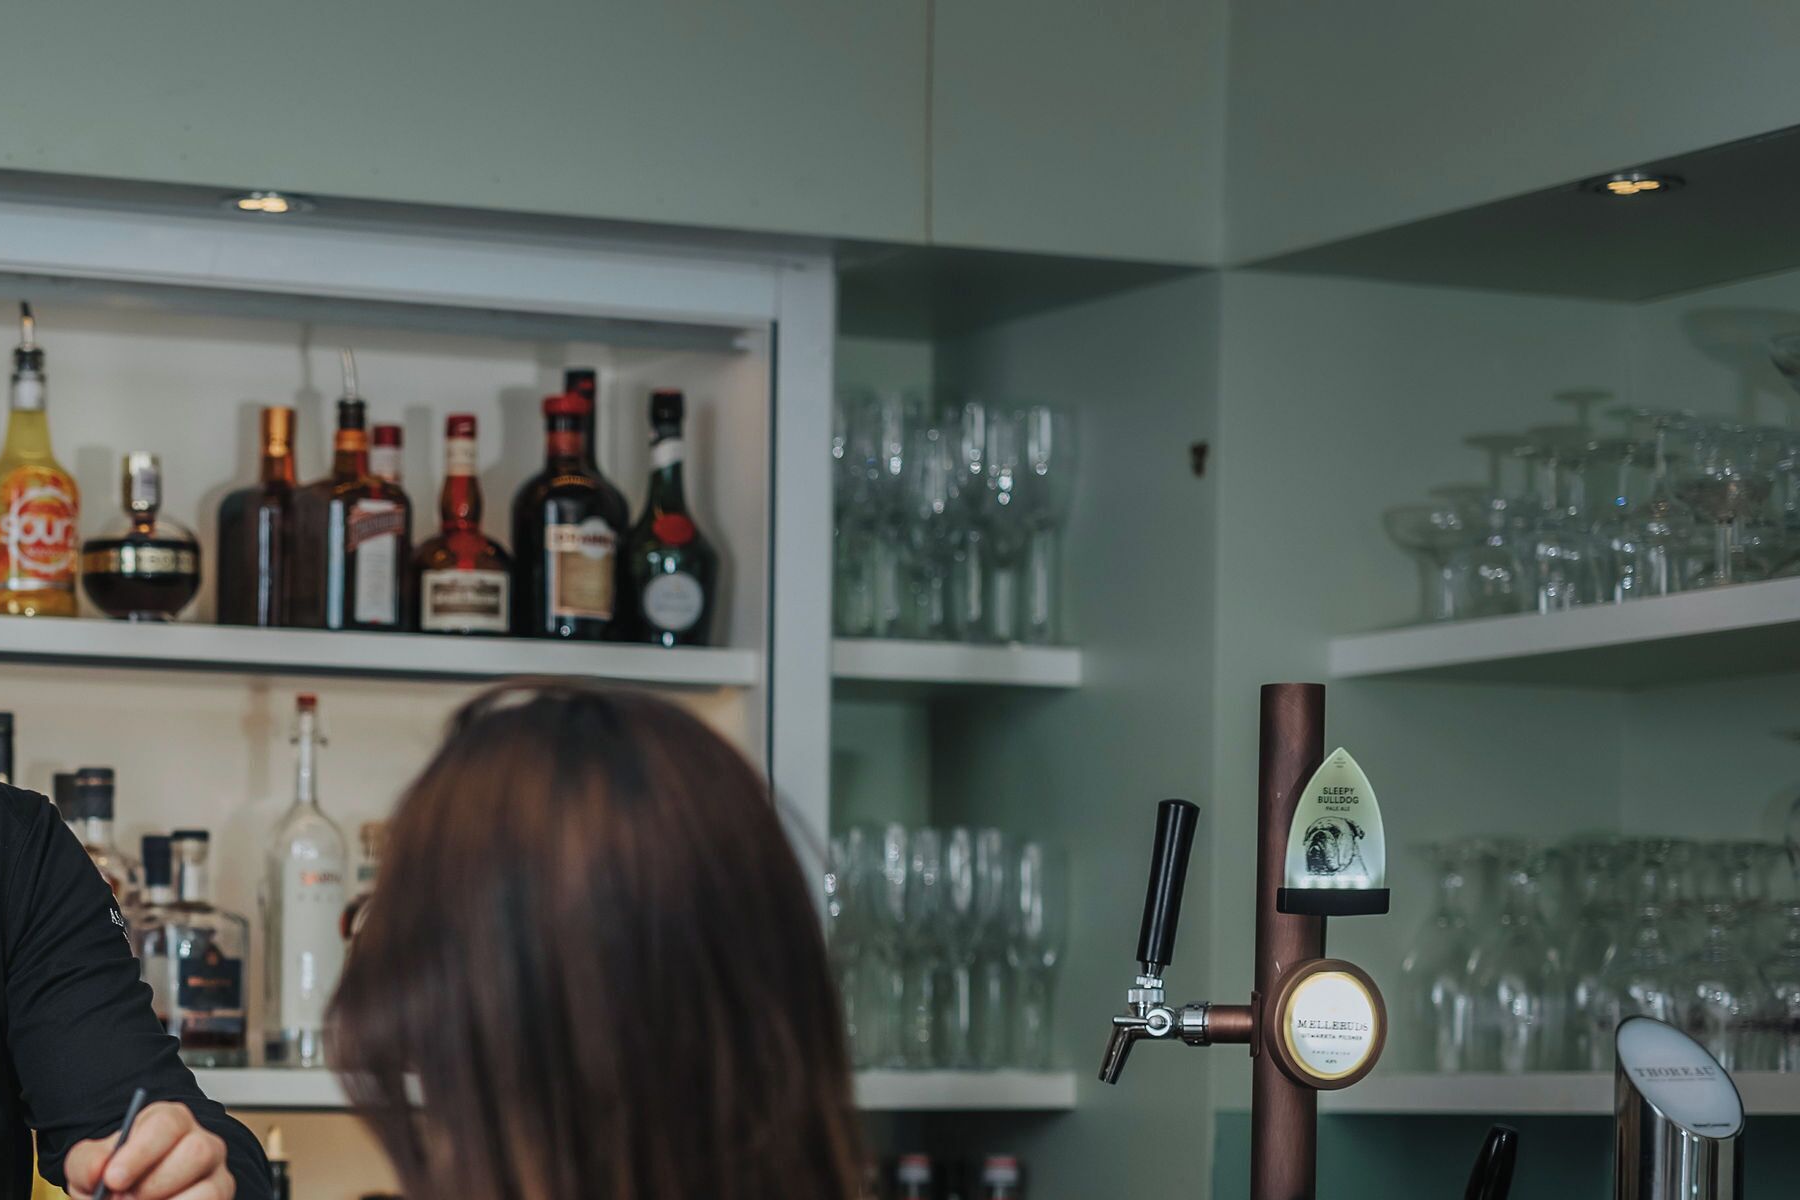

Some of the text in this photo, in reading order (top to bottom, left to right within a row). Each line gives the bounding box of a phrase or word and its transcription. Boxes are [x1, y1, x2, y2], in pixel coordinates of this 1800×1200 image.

[1322, 786, 1355, 796] SLEEPY
[1317, 796, 1360, 805] BULLDOG
[1297, 1019, 1369, 1032] MELLERUDS
